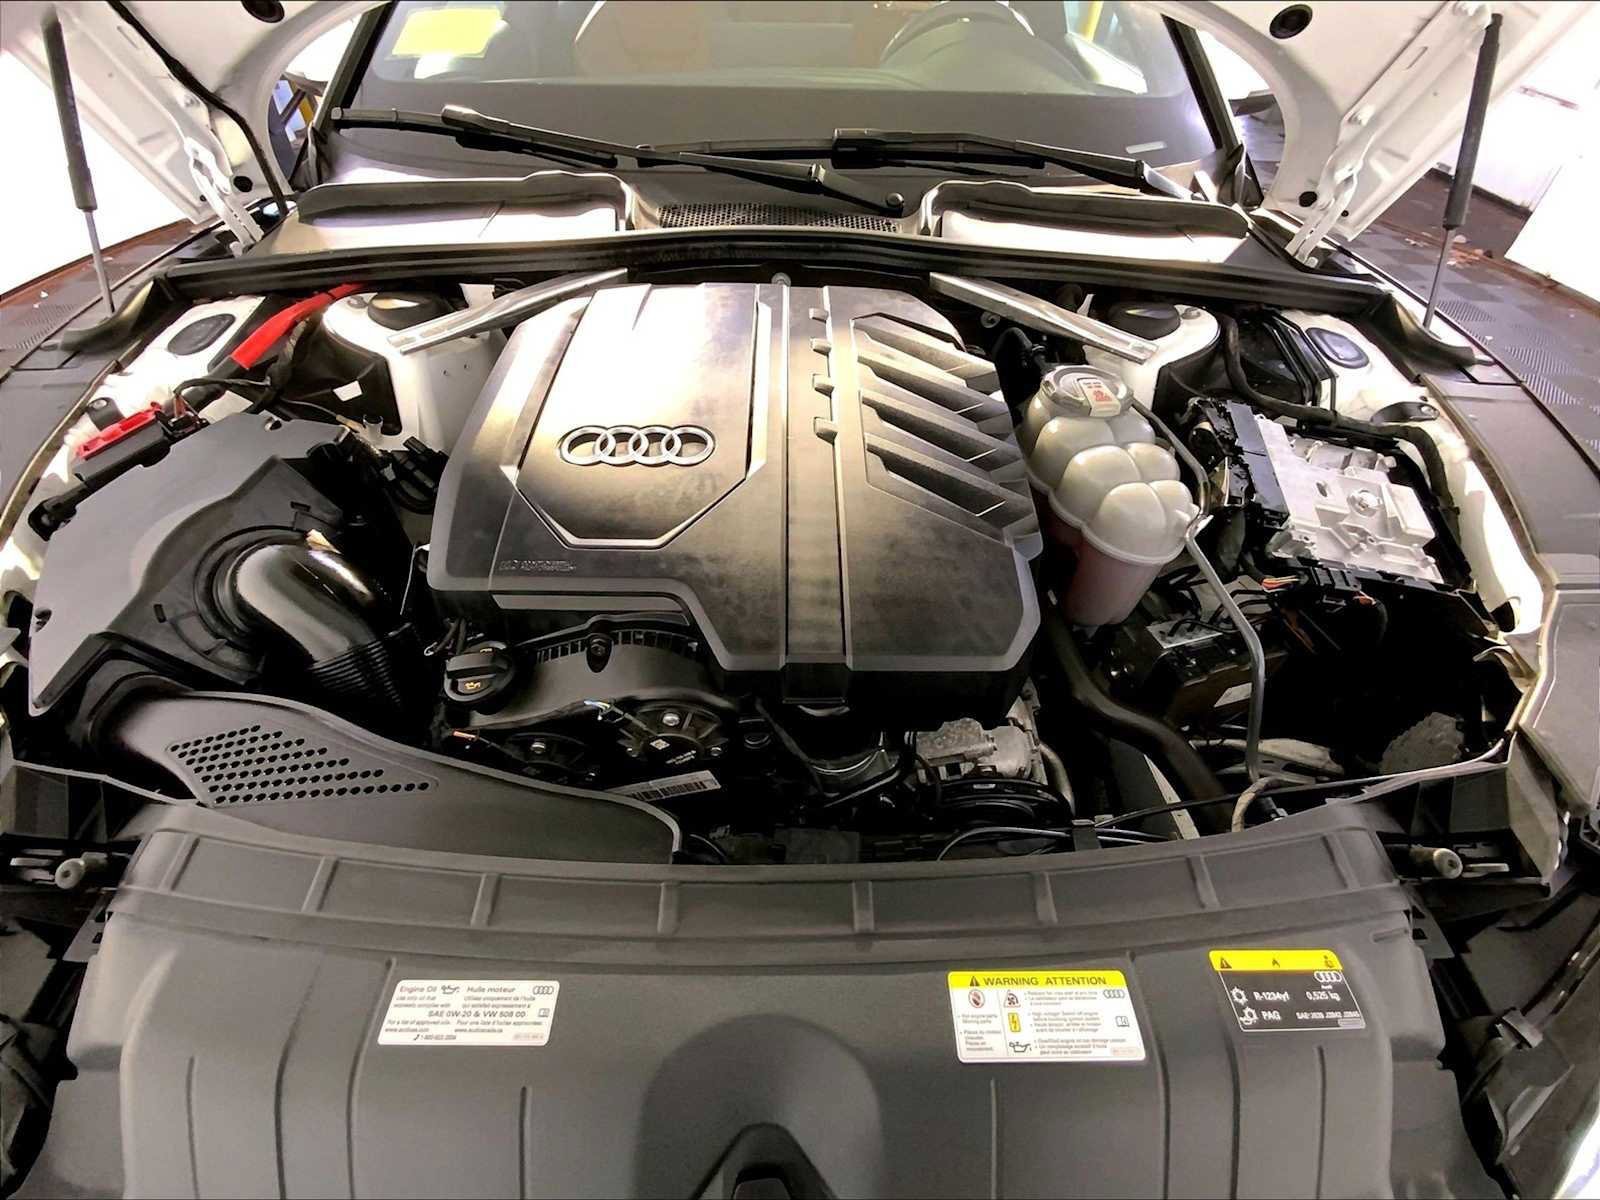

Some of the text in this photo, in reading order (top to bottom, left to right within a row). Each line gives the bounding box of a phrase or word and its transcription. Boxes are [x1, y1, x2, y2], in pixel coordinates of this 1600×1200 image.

[983, 976, 1107, 986] WARNING ATTENTION
[400, 986, 425, 994] Engine
[1253, 991, 1290, 1003] R-1234yf
[1329, 991, 1341, 1002] kg
[483, 1010, 498, 1018] VW
[1261, 1010, 1282, 1021] PAG
